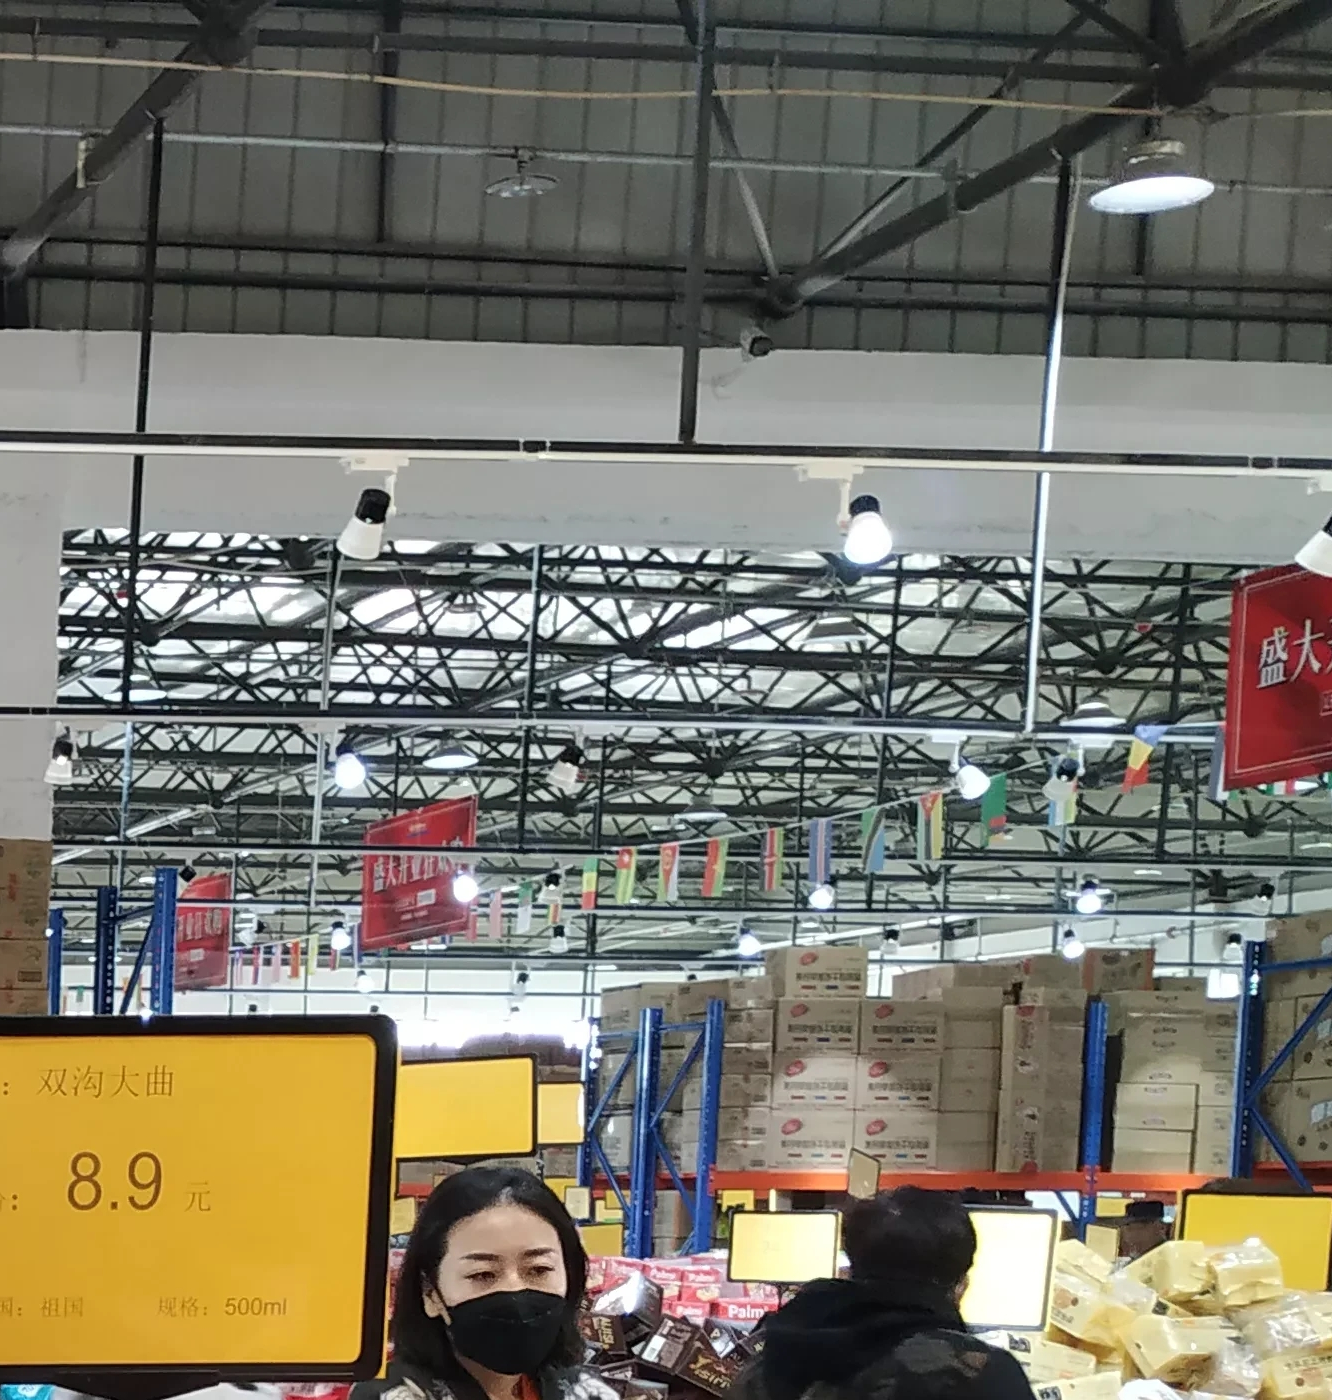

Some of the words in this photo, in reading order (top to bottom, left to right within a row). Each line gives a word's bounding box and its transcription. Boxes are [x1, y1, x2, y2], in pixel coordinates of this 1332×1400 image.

[1257, 618, 1332, 690] 盛大
[36, 1065, 175, 1100] 双沟大曲
[66, 1150, 163, 1212] 8.9
[184, 1180, 212, 1212] 元
[40, 1297, 85, 1319] 祖国
[156, 1296, 210, 1319] 规格:
[223, 1297, 287, 1317] 500ml
